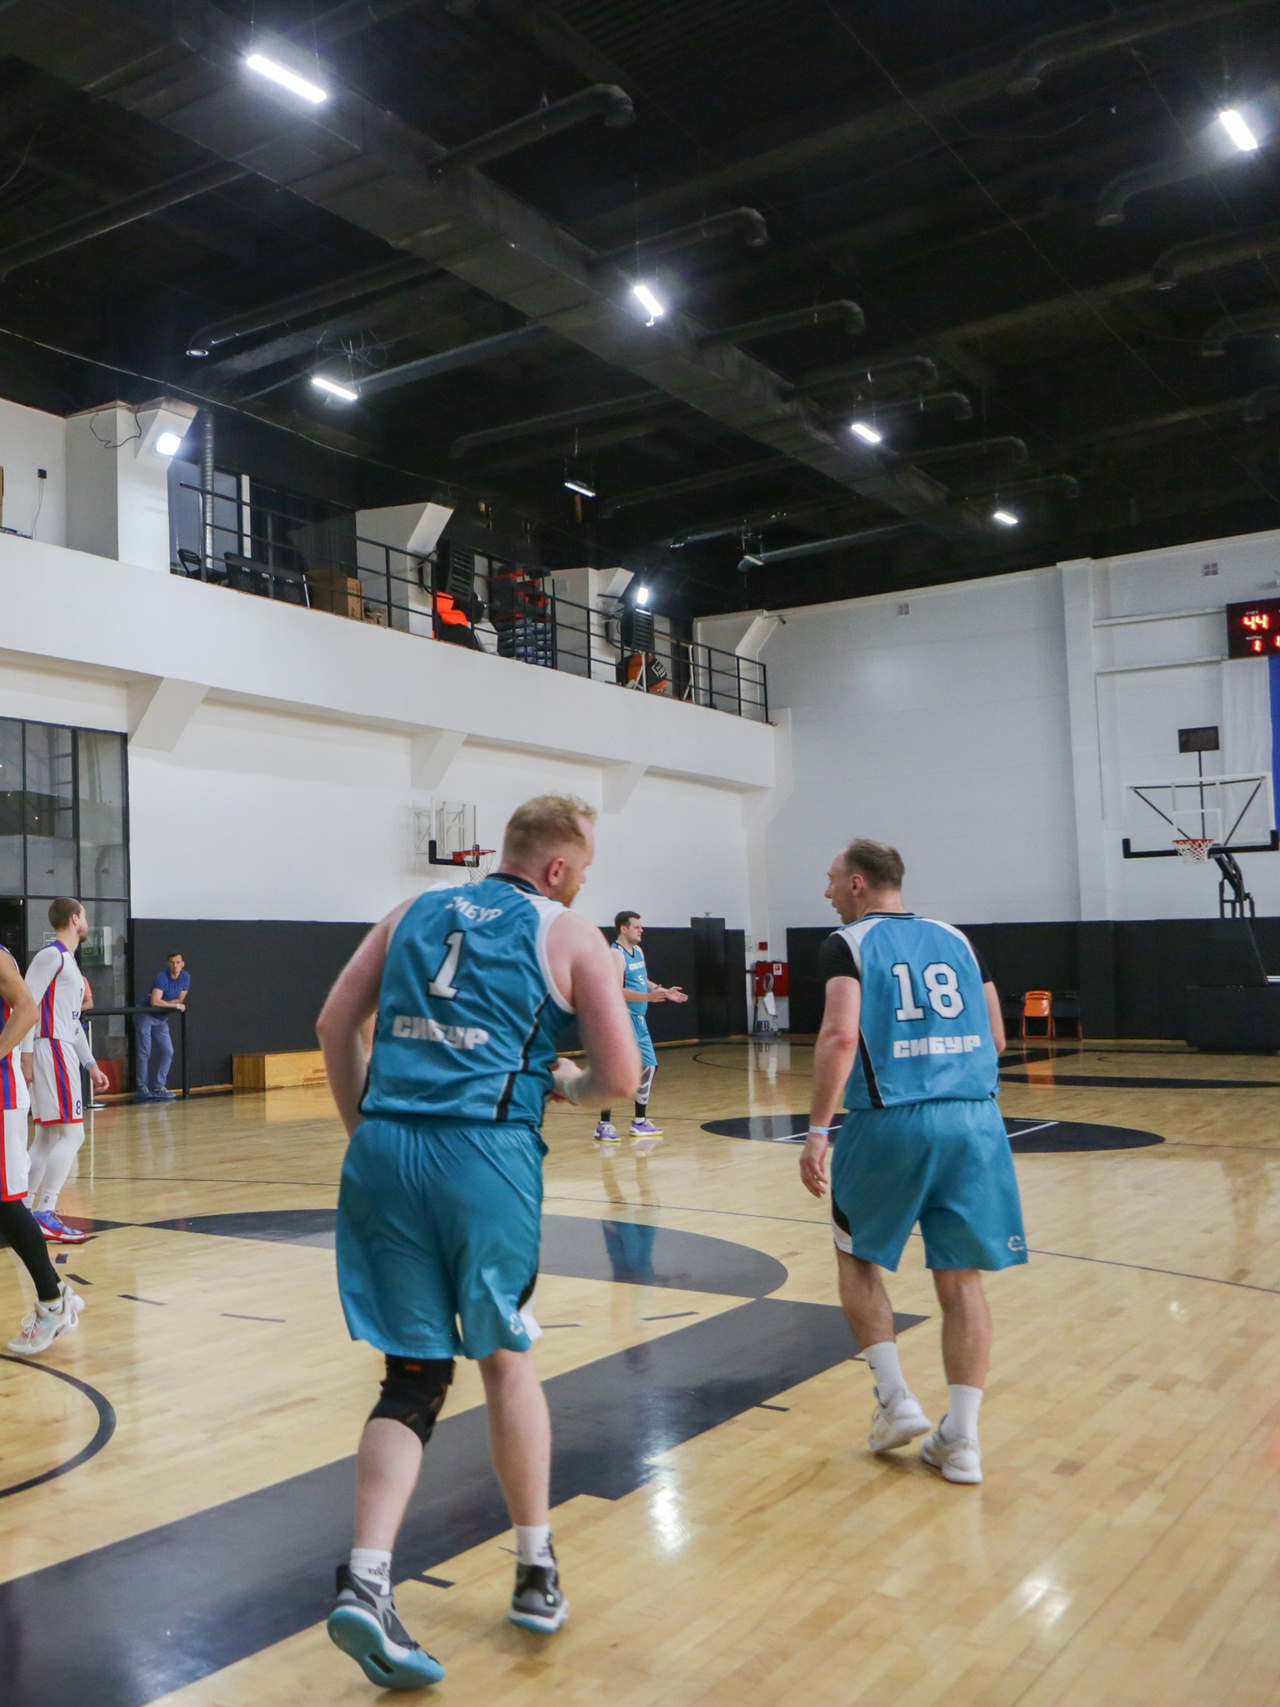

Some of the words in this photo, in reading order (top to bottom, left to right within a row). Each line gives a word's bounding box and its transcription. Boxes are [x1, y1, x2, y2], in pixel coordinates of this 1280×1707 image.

[1242, 614, 1269, 630] 44
[426, 929, 466, 1000] 1
[637, 974, 646, 985] 5
[891, 962, 966, 1022] 18
[392, 1015, 490, 1050] СИБУР
[893, 1035, 981, 1059] СИБУР
[75, 1099, 82, 1116] 8
